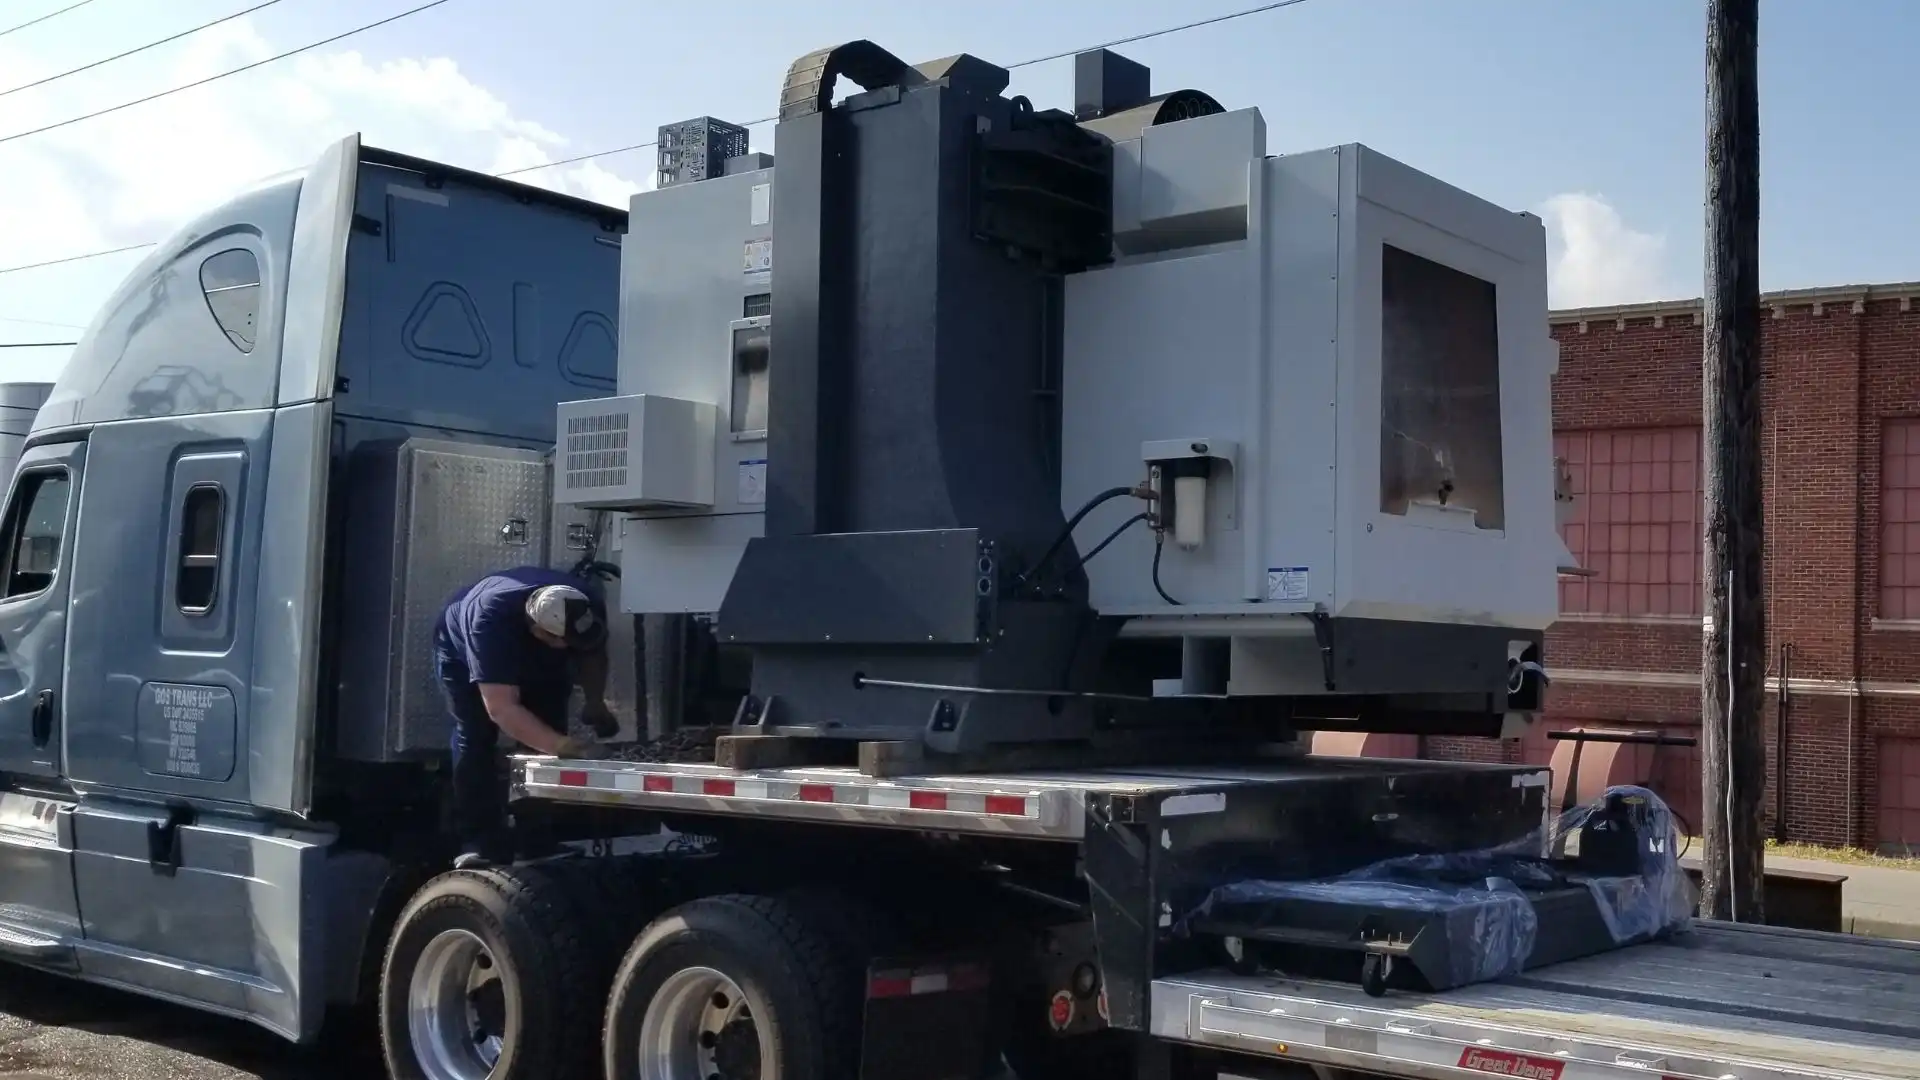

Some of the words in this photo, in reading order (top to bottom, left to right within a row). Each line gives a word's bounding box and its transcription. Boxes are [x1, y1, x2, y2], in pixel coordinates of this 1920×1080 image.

[172, 688, 197, 708] TRANS
[198, 690, 213, 709] LLC
[1465, 1049, 1512, 1074] Great
[1511, 1057, 1556, 1080] Dane
